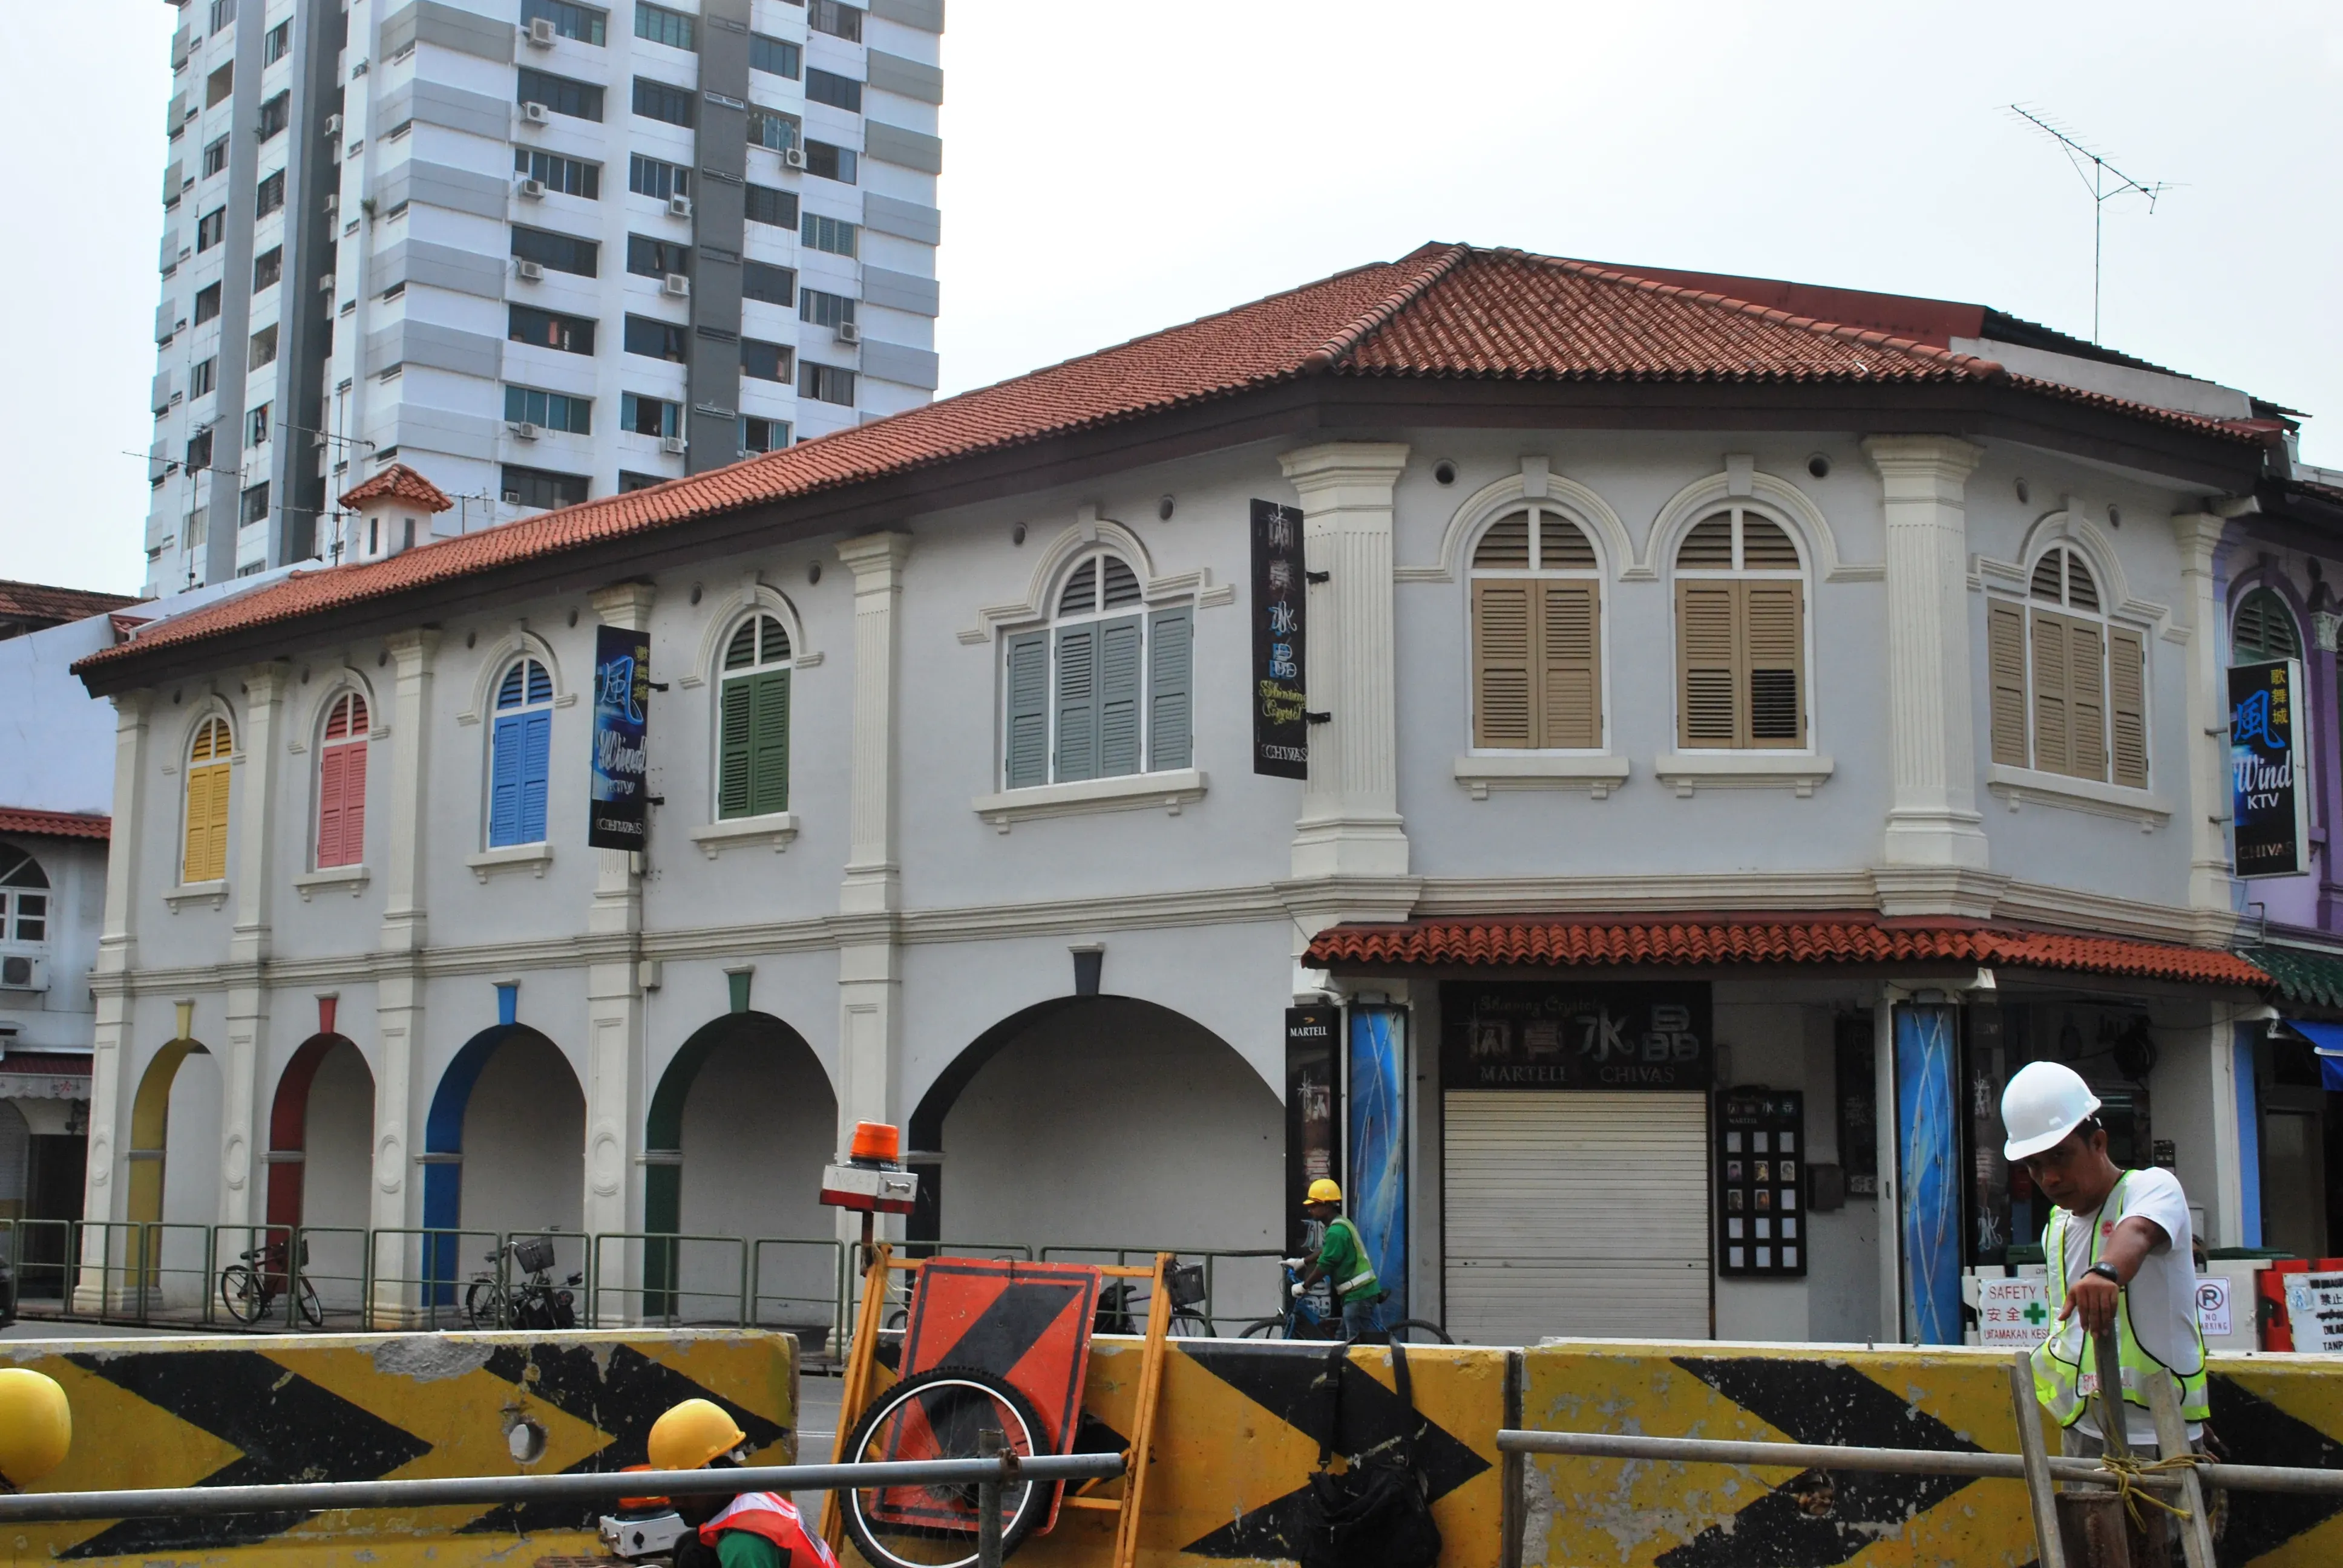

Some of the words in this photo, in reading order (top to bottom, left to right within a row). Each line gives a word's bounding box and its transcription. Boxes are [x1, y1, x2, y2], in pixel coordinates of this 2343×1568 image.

[601, 655, 644, 725] 風
[2270, 668, 2288, 725] 歌舞城
[2233, 690, 2285, 748] 風
[597, 728, 647, 774] Wind
[2233, 750, 2292, 793] Wind
[2247, 793, 2279, 809] KTV
[2239, 841, 2294, 859] CHIVAS
[1289, 1025, 1328, 1038] MARTELL
[1480, 1066, 1567, 1082] MARTELL
[1599, 1065, 1676, 1083] CHIVAS
[1989, 1286, 2037, 1299] SAFETY
[1987, 1307, 2020, 1322] 安全
